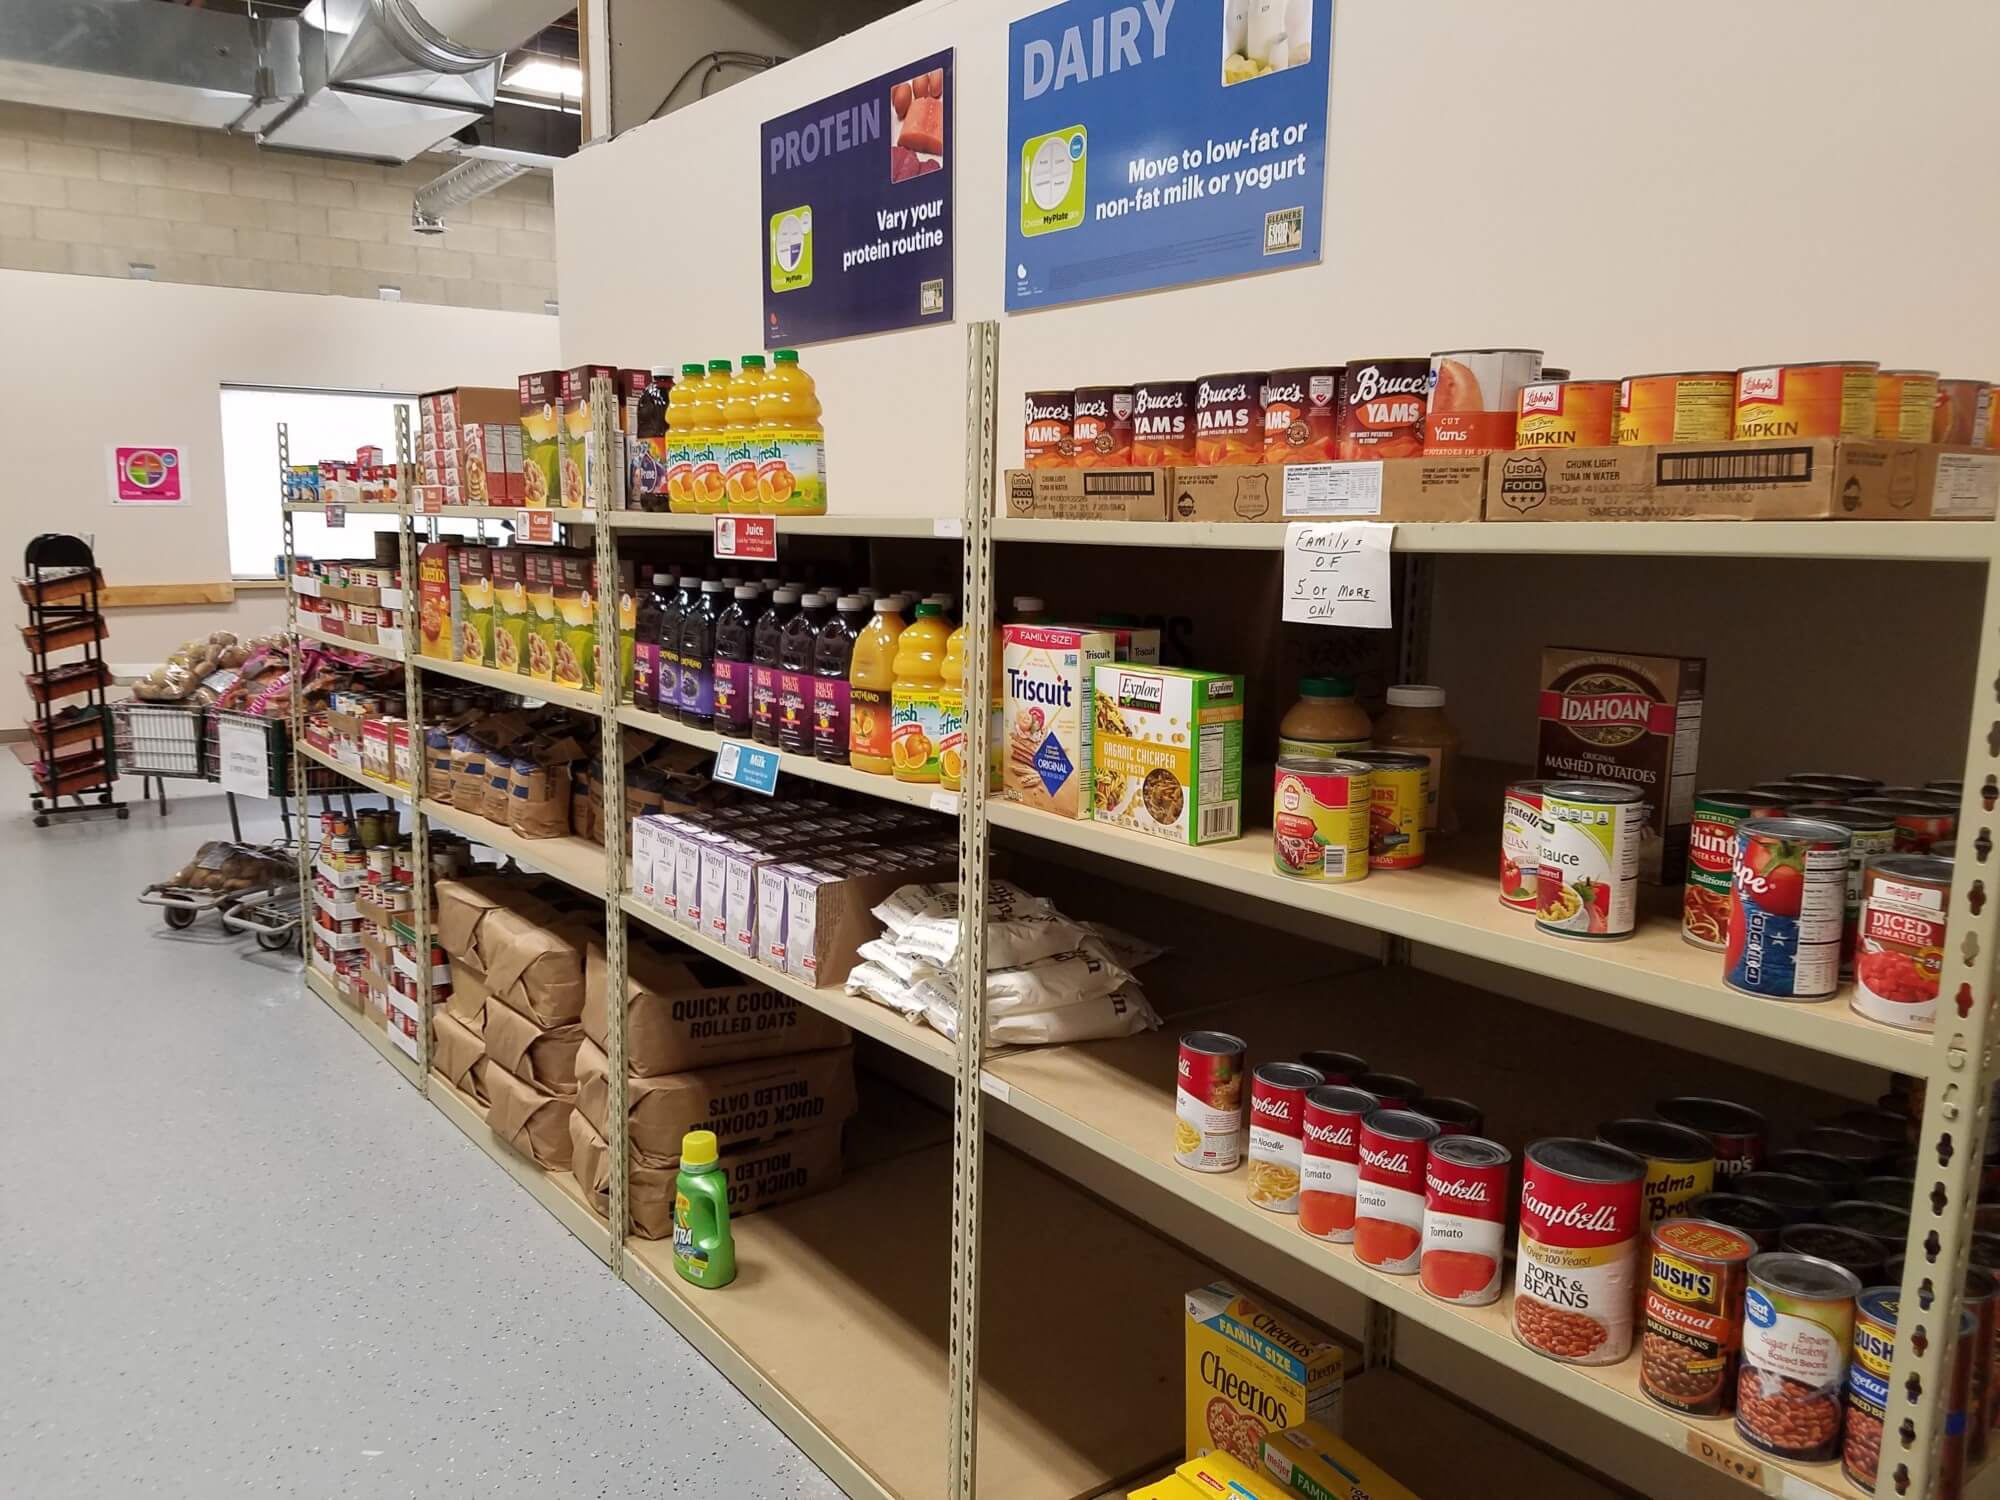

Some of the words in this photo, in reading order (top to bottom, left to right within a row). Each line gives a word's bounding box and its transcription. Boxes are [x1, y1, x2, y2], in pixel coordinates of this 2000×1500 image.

[1023, 0, 1176, 101] DAIRY
[770, 99, 880, 175] PROTEIN
[1128, 155, 1178, 184] Move
[1182, 150, 1202, 170] to
[1206, 128, 1280, 165] low-fat
[1283, 122, 1308, 146] or
[1095, 188, 1161, 220] non-fat
[1163, 176, 1205, 204] milk
[1208, 173, 1231, 195] or
[1234, 153, 1306, 194] yogurt
[877, 208, 908, 232] Vary
[910, 199, 943, 227] your
[1266, 211, 1301, 224] GLEANERS
[843, 239, 890, 272] protein
[892, 227, 944, 257] routine
[1198, 381, 1247, 409] Bruce's
[1268, 384, 1304, 402] uce's
[1350, 365, 1430, 405] Bruce's
[1025, 397, 1072, 425] Bruce's
[1134, 388, 1184, 414] Bruce's
[1526, 391, 1553, 407] Libby's
[1197, 408, 1249, 429] YAMS
[1266, 410, 1291, 429] AMS
[1366, 402, 1419, 423] YAMS
[1441, 417, 1460, 425] CUT
[1027, 427, 1061, 442] YAMS
[1074, 423, 1097, 440] AMS
[1135, 416, 1185, 434] YAMS
[1434, 426, 1468, 441] Yams
[1735, 422, 1799, 438] MPKIN
[1507, 464, 1542, 475] USDA
[1560, 472, 1581, 481] TUNA
[1582, 472, 1591, 481] IN
[1592, 471, 1620, 481] WATER
[1566, 460, 1597, 470] CHUNK
[1598, 458, 1617, 469] LIGHT
[1504, 481, 1543, 491] FOOD
[745, 523, 764, 536] Juice
[1315, 556, 1341, 568] OF
[1020, 631, 1049, 643] FAMILY
[1051, 635, 1073, 646] SIZE!
[1085, 649, 1110, 660] Triscuit
[850, 690, 879, 702] ORTHLAND
[1007, 668, 1072, 707] Triscuit
[1121, 677, 1160, 698] Explore
[1560, 697, 1650, 722] IDAHOAN
[1038, 758, 1068, 774] ORIGINAL
[1103, 741, 1134, 761] ORGANIC
[1136, 744, 1176, 769] CHICKPEA
[1582, 751, 1616, 764] ORIGINAL
[1544, 756, 1594, 775] MASHED
[1596, 763, 1656, 784] POTATOES
[1506, 802, 1541, 828] Fratelli
[1690, 825, 1736, 854] Hunt
[705, 852, 723, 868] Natrel
[1543, 847, 1579, 866] sauce
[1710, 855, 1733, 865] SAUC
[730, 862, 749, 878] Natrel
[761, 874, 782, 890] Natrel
[1690, 870, 1732, 887] Traditiona
[793, 883, 816, 901] Natrel
[1871, 926, 1933, 947] TOMATOES
[1872, 912, 1932, 937] DICED
[672, 995, 730, 1022] QUICK
[737, 991, 803, 1013] COOKI
[690, 1016, 749, 1039] ROLLED
[757, 1011, 797, 1031] OATS
[709, 1093, 750, 1117] OATS
[754, 1080, 808, 1106] ROLLED
[775, 1097, 824, 1124] QUICK
[1258, 1138, 1284, 1151] Noodle
[1303, 1120, 1353, 1146] ampbell's
[736, 1152, 791, 1182] ROLLED
[1359, 1144, 1410, 1174] ampbell's
[757, 1168, 807, 1196] QUICK
[1304, 1168, 1332, 1180] Tomato
[1359, 1194, 1386, 1208] Tomato
[1522, 1178, 1618, 1233] Campbell's
[1430, 1227, 1463, 1239] Tomato
[1526, 1245, 1544, 1262] Over
[1544, 1252, 1560, 1264] 100
[1561, 1255, 1591, 1267] Years!
[1527, 1262, 1567, 1289] PORK
[1569, 1278, 1584, 1293] &
[1652, 1256, 1712, 1295] BUSH'S
[1523, 1274, 1589, 1309] BEANS
[1648, 1295, 1714, 1330] Original
[1219, 1318, 1263, 1354] FAMILY
[1265, 1345, 1291, 1372] SIZE
[1252, 1313, 1315, 1358] Cheerios
[1672, 1327, 1709, 1351] BEANS
[1854, 1325, 1895, 1364] BUSH
[1308, 1360, 1342, 1385] Cheerios
[1200, 1350, 1288, 1429] Cheerios
[1266, 1452, 1291, 1478] meijer
